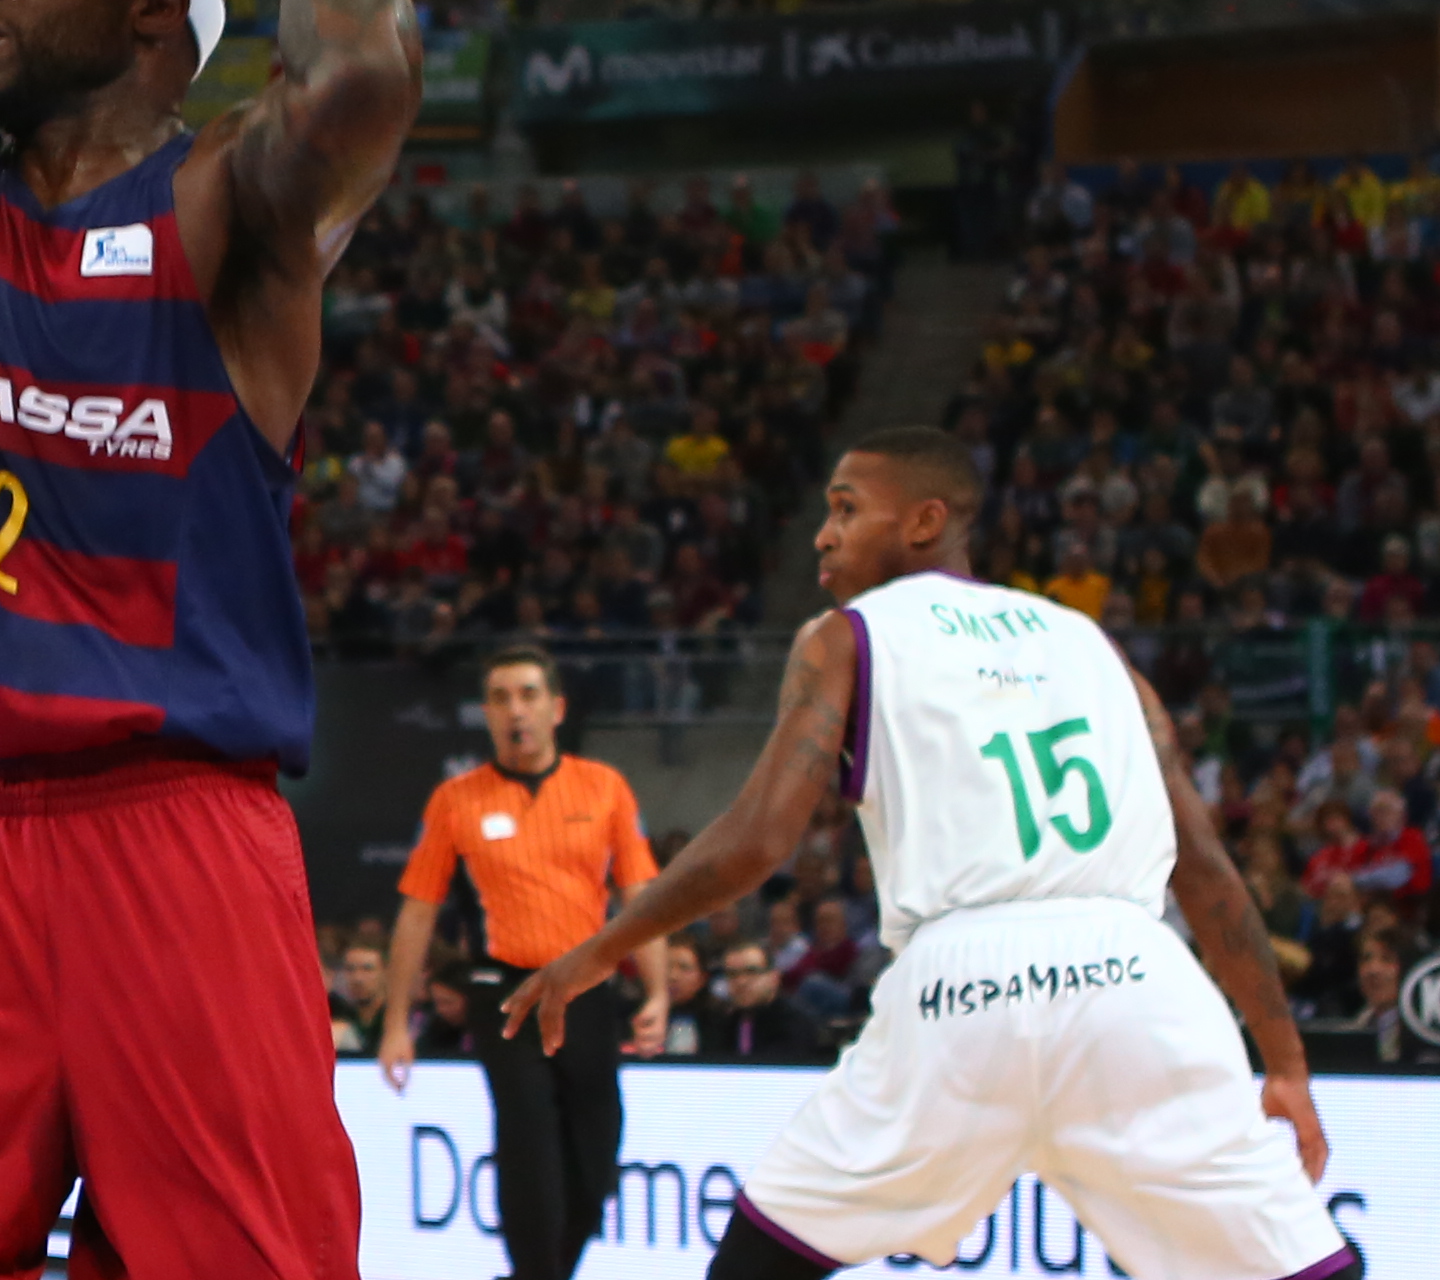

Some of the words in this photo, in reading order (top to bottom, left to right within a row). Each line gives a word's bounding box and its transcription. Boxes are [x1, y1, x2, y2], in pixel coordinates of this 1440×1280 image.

[88, 438, 171, 460] TYRES
[931, 603, 1048, 643] SMITH
[979, 717, 1112, 861] 15
